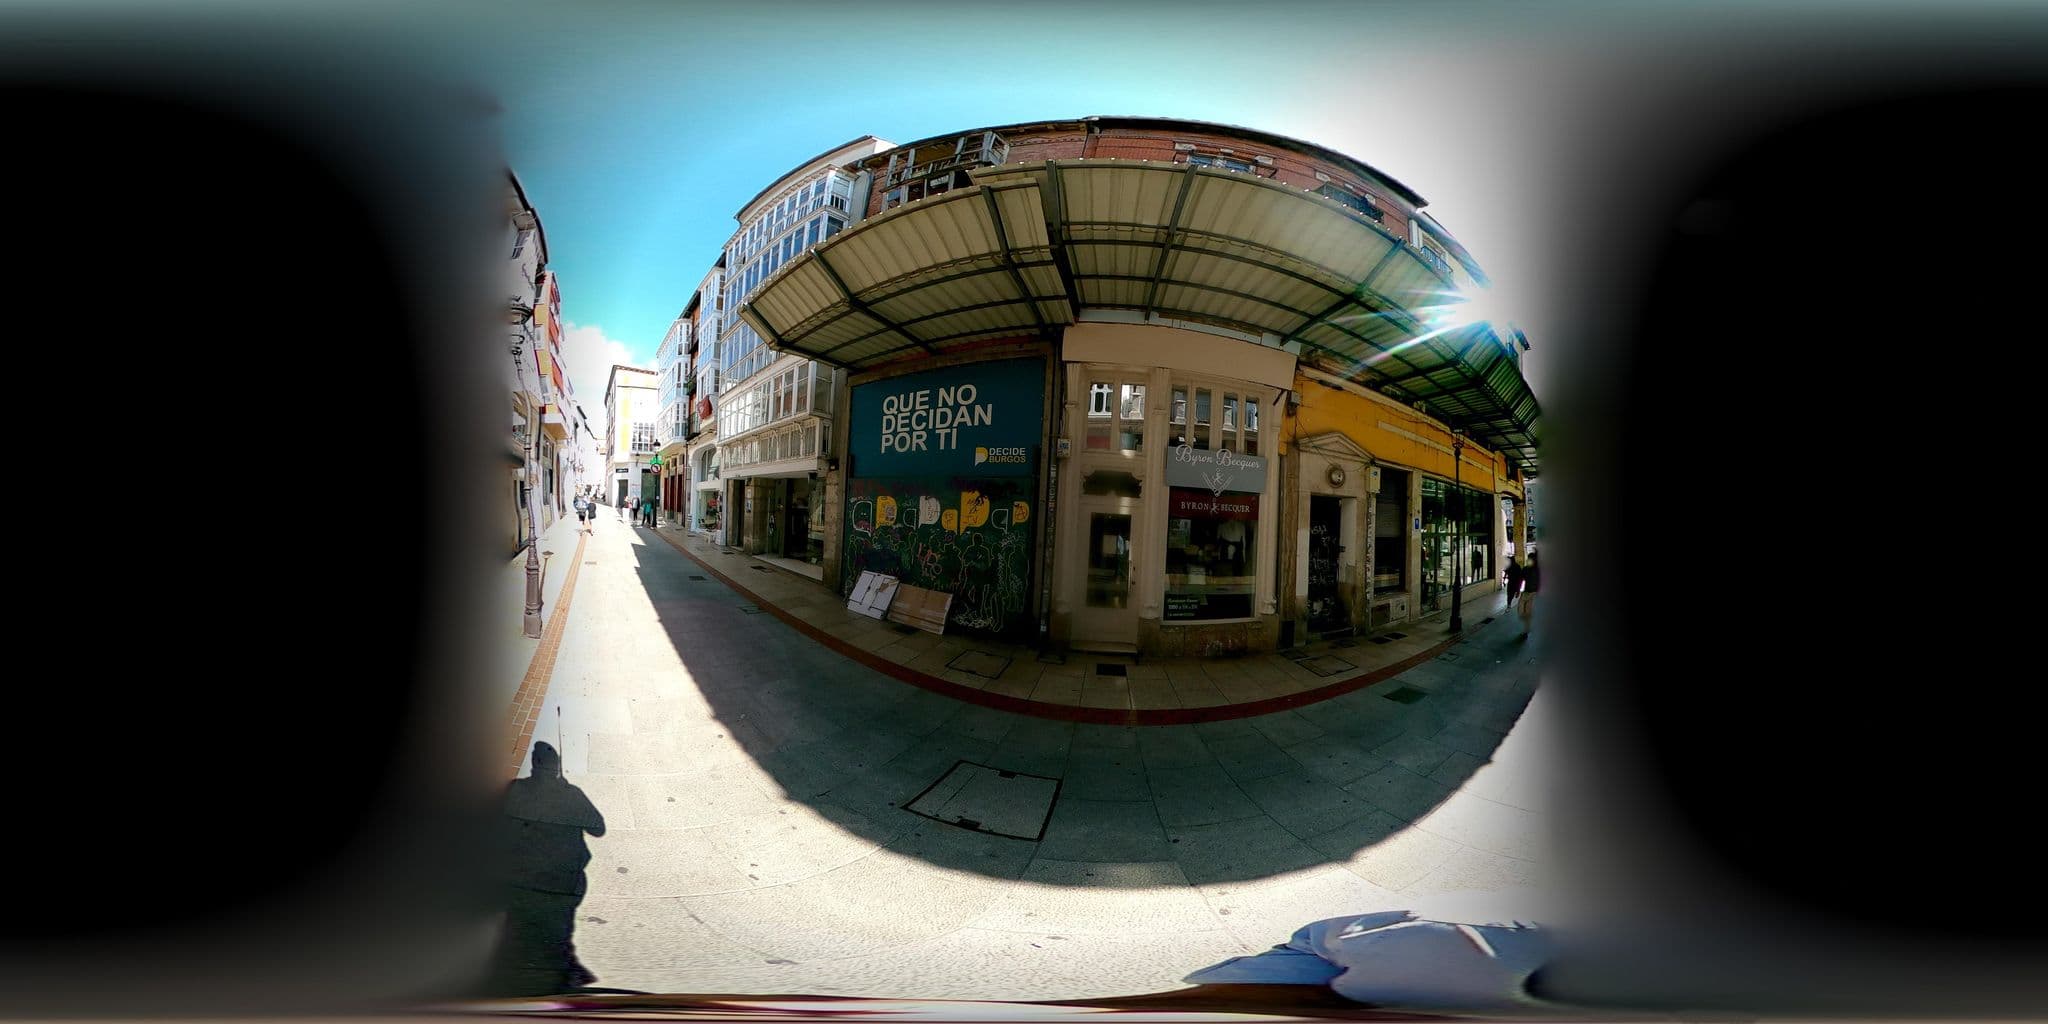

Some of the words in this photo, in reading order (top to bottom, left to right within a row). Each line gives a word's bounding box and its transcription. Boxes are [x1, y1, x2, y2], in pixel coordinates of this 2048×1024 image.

[883, 390, 930, 415] QUE
[937, 384, 977, 408] NO
[882, 404, 992, 434] DECIDAN
[881, 430, 928, 454] POR
[936, 428, 958, 450] TI
[988, 447, 1026, 456] DECIDE
[988, 455, 1026, 463] BURGOS
[1175, 444, 1212, 466] Byron
[1216, 448, 1260, 470] Becquer
[1180, 501, 1209, 510] BYRON
[1220, 503, 1250, 513] BECQUER
